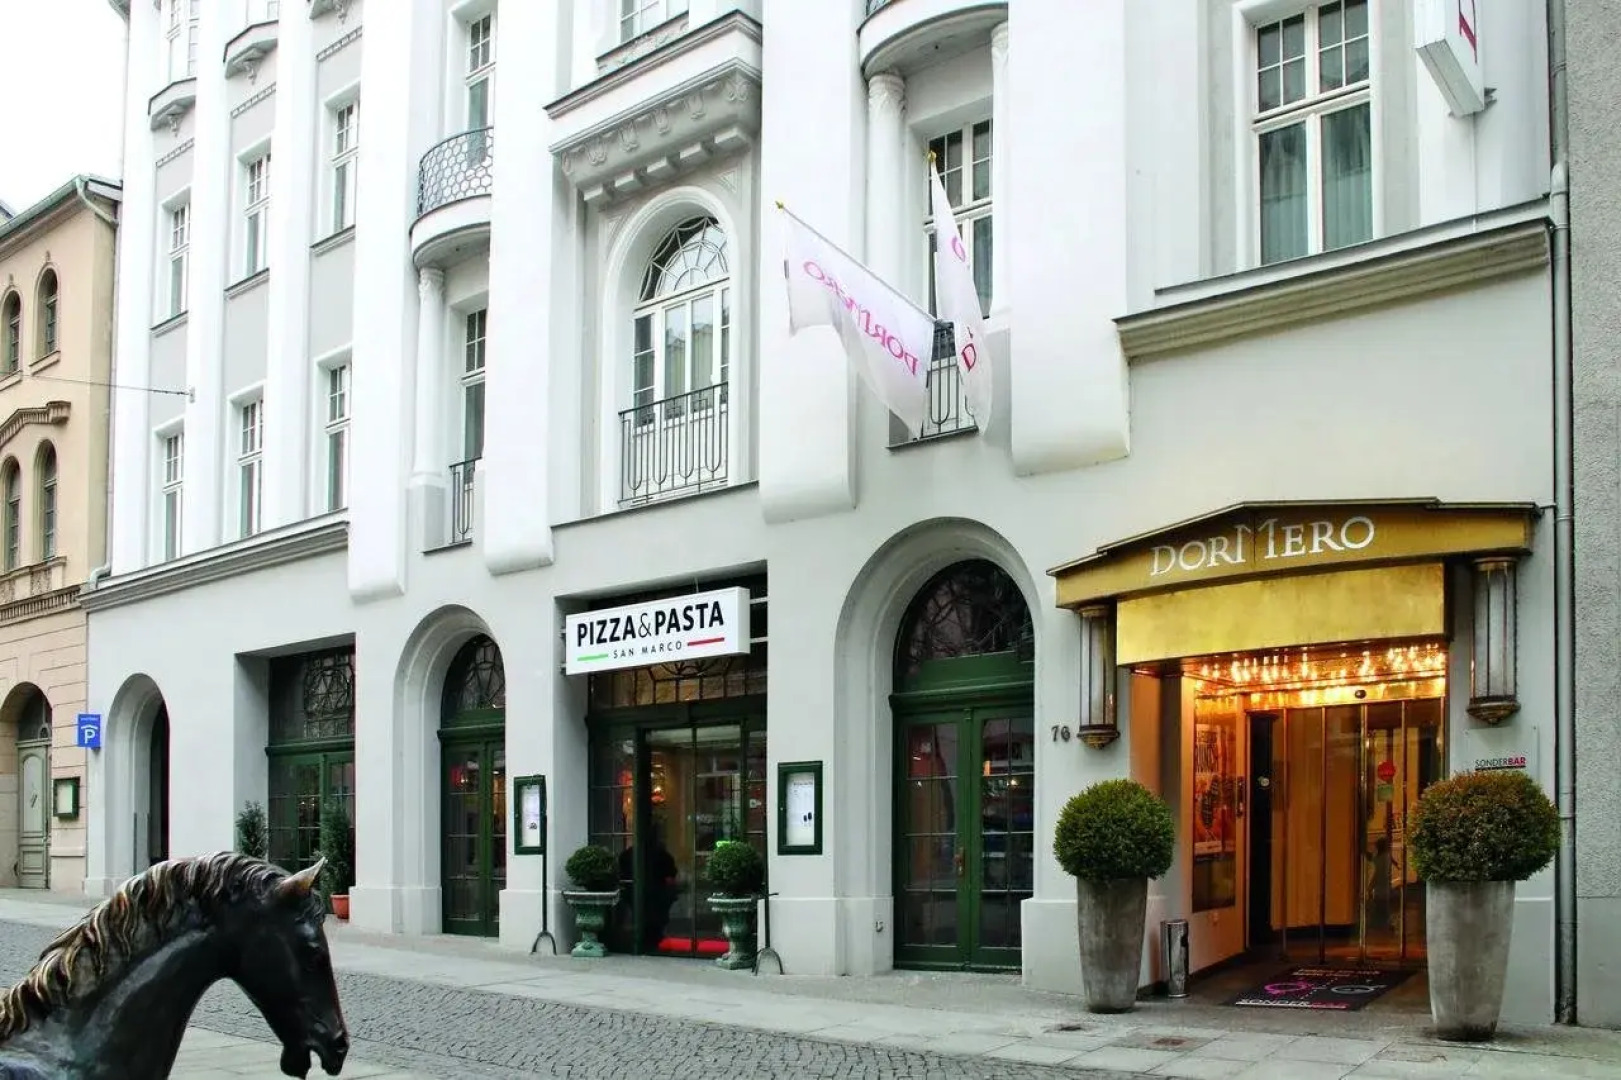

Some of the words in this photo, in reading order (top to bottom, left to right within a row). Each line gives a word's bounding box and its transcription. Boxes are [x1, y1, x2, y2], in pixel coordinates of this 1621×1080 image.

[1150, 516, 1375, 576] DORMERO
[613, 649, 635, 659] SAN
[641, 640, 682, 654] MARCO
[84, 728, 96, 744] P
[1051, 725, 1071, 742] 76
[1475, 756, 1526, 767] SONDERBAR
